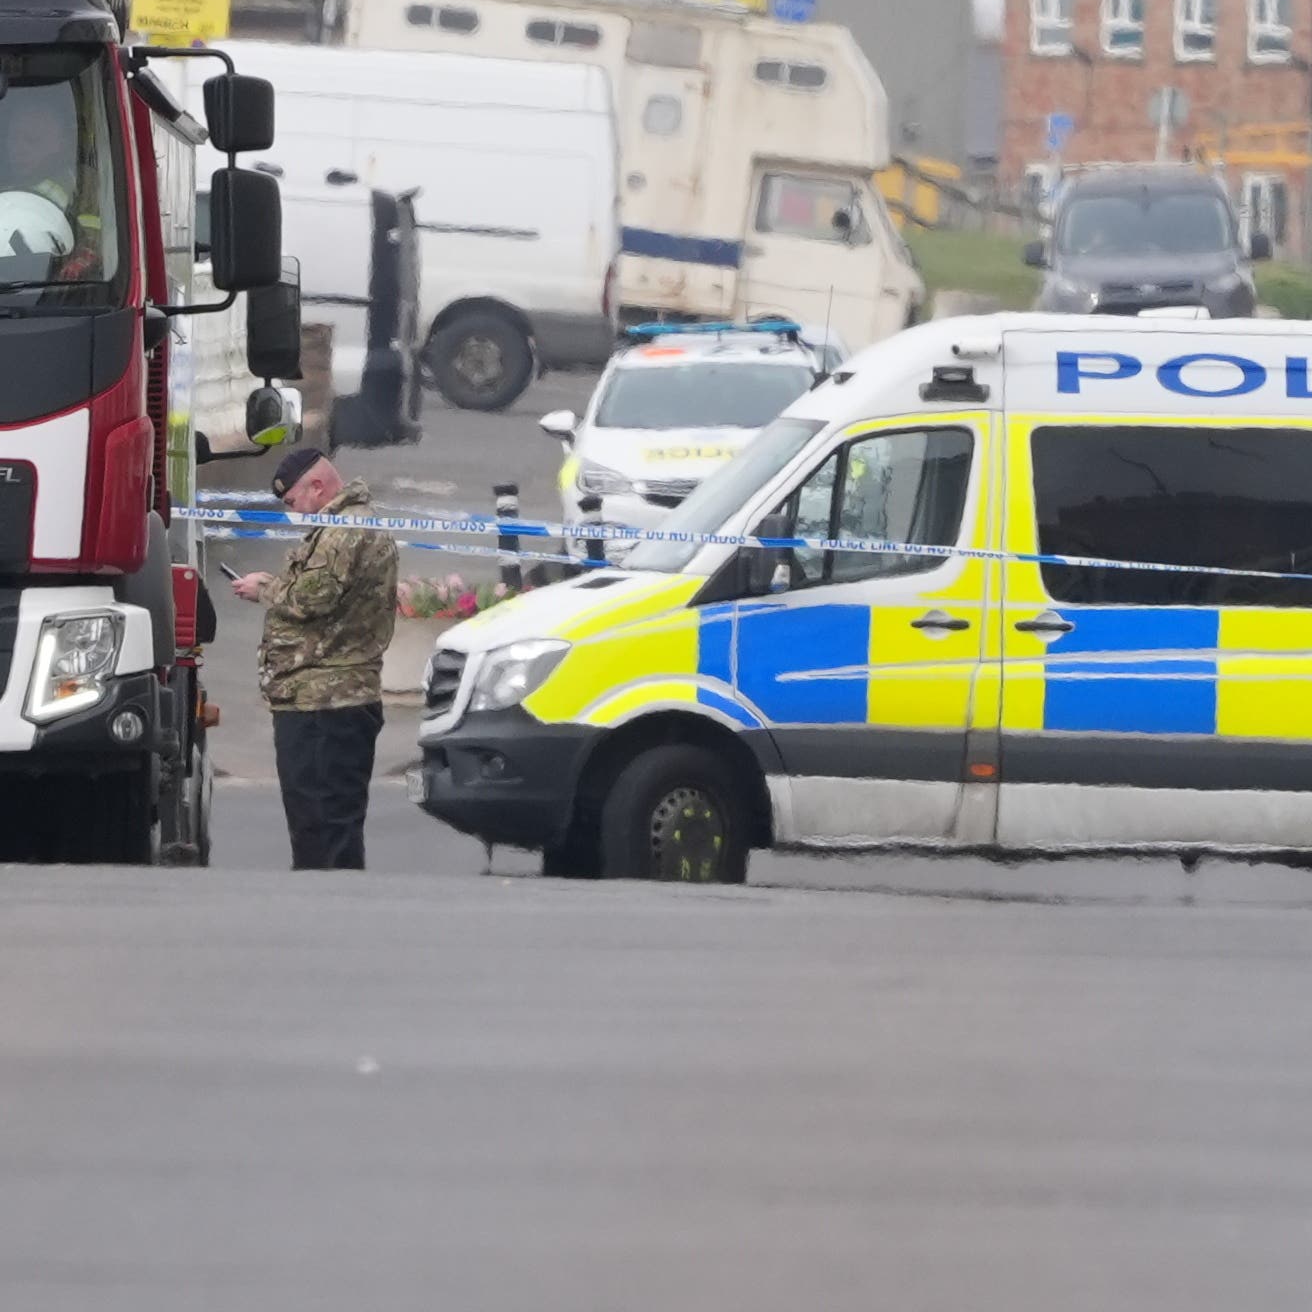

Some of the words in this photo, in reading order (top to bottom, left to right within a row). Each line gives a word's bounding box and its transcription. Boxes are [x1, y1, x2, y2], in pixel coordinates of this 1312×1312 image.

[301, 513, 348, 525] POLICE
[354, 515, 382, 527] LINE
[388, 517, 406, 528] DO
[410, 519, 435, 530] NOT
